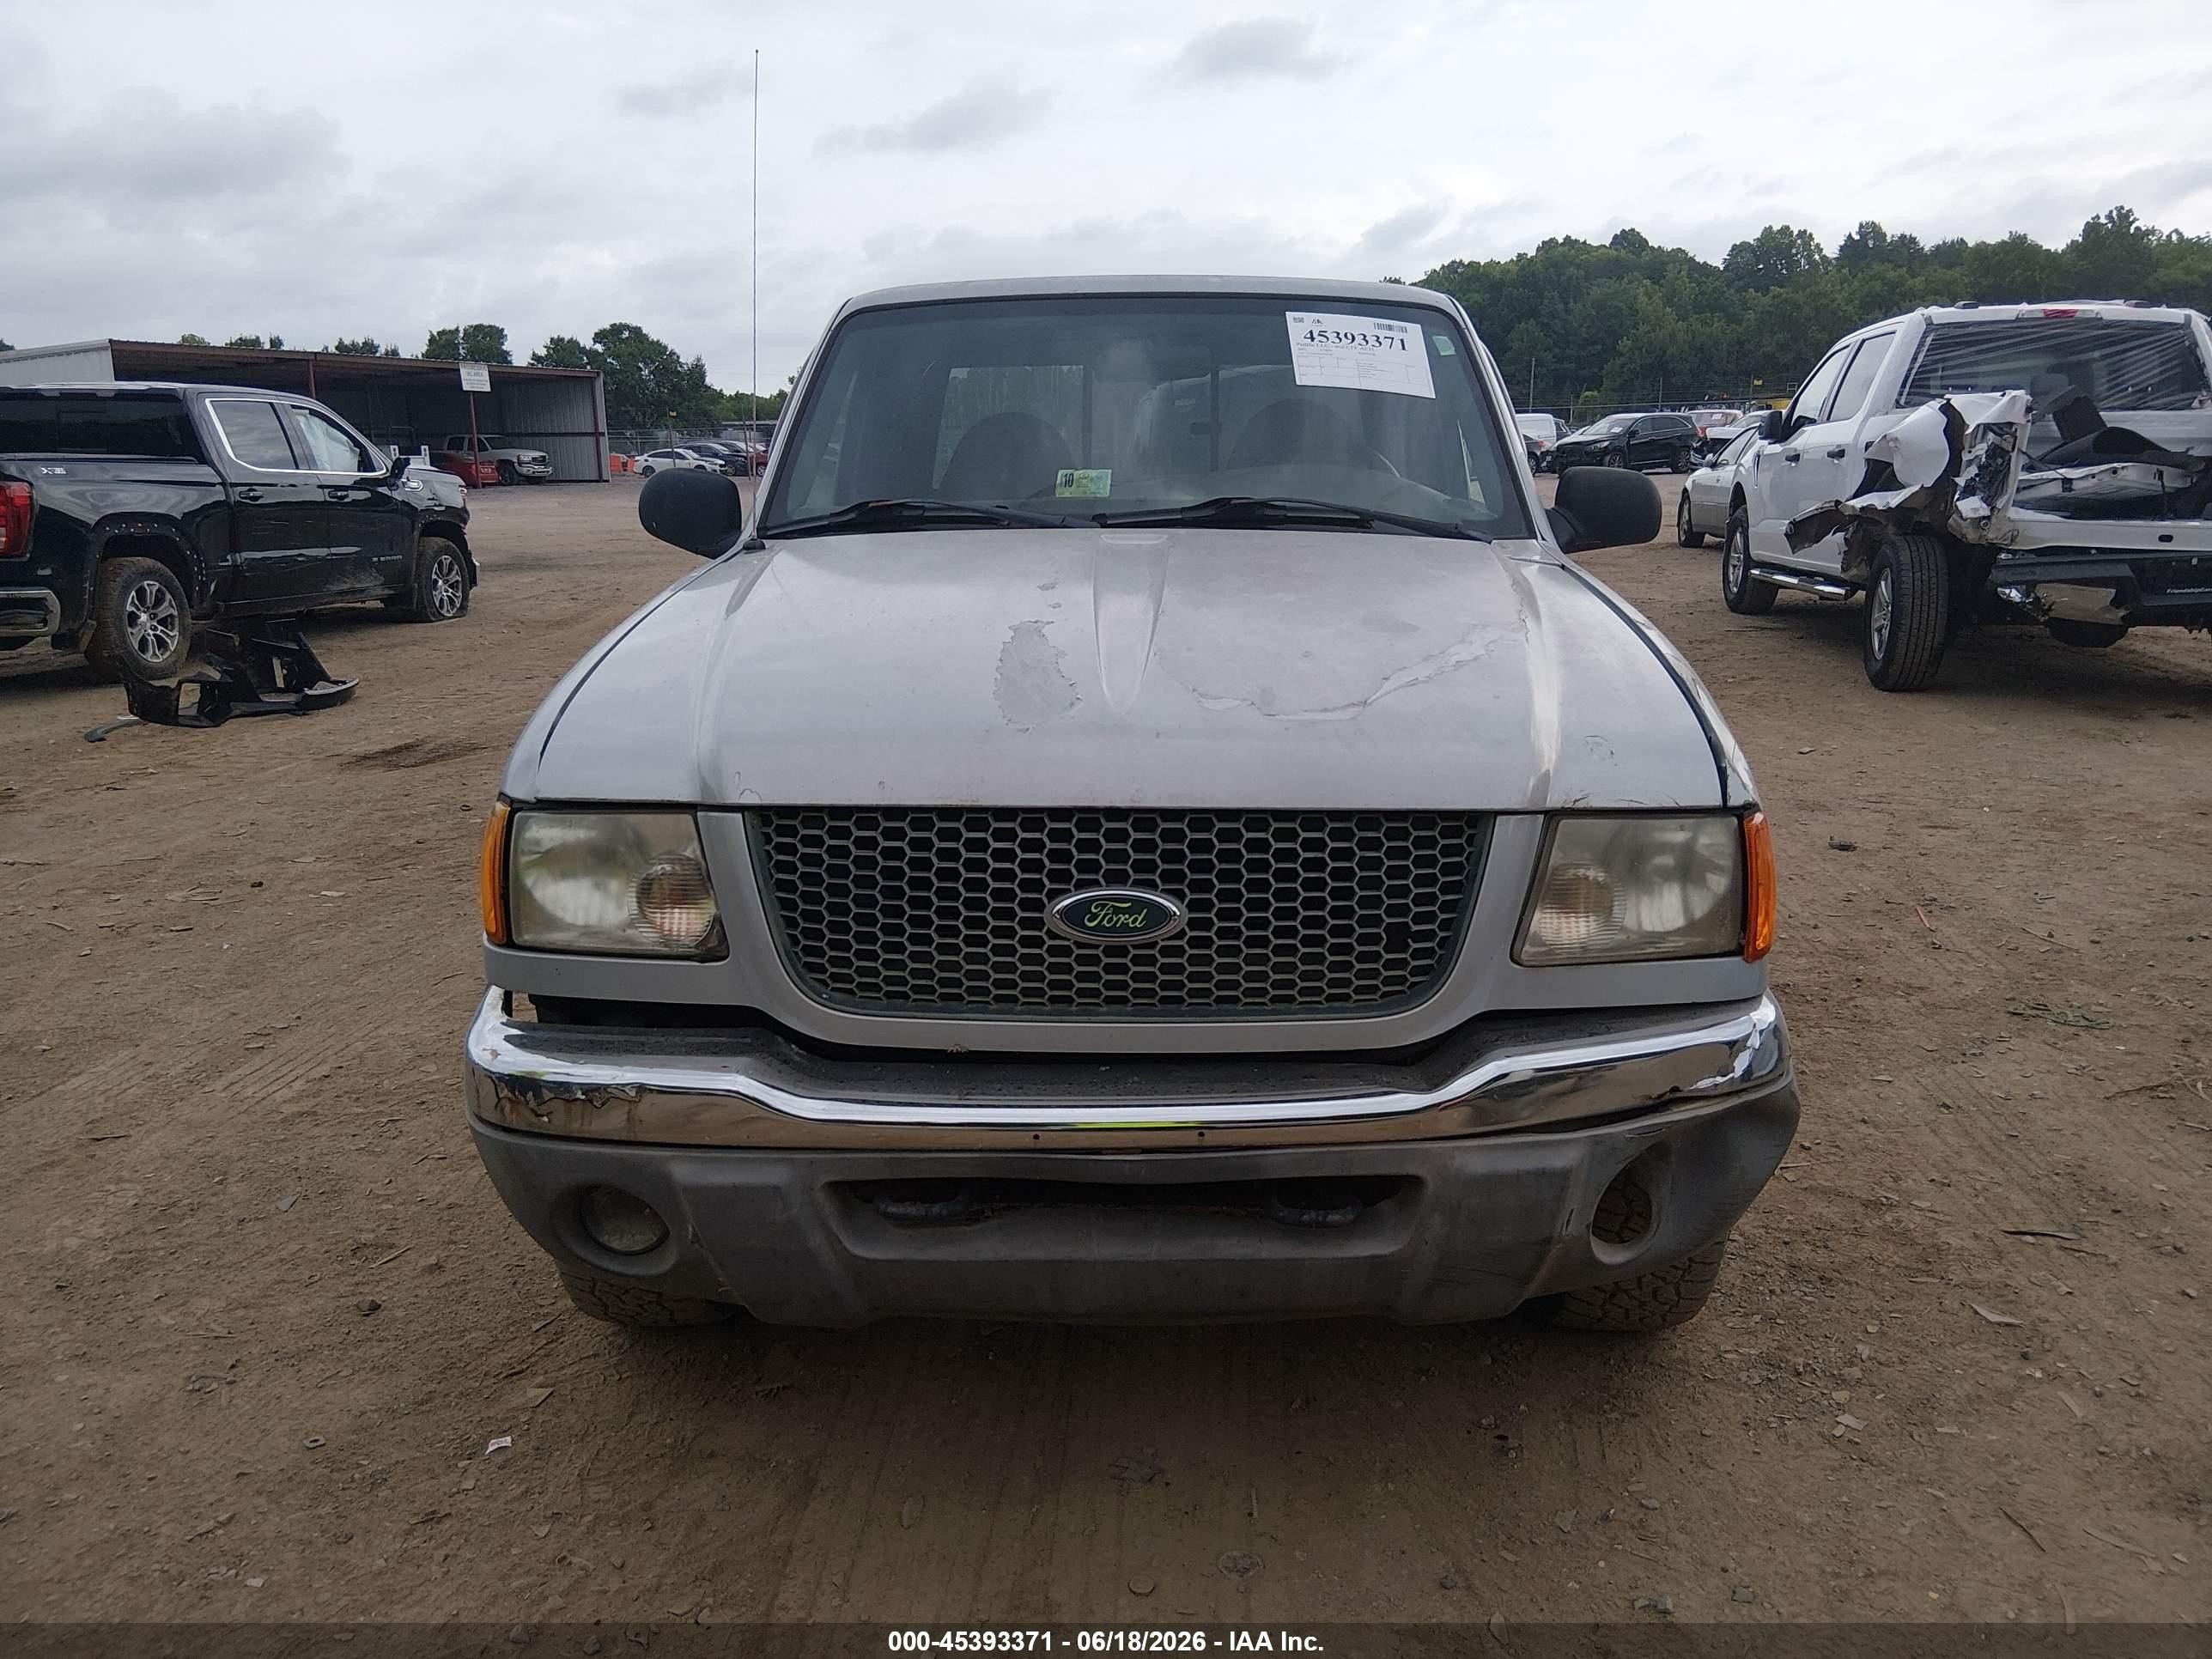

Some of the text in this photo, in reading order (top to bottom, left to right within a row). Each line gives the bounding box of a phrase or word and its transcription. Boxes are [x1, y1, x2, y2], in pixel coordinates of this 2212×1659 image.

[1304, 329, 1408, 352] 45393371
[1064, 472, 1074, 488] 10
[1085, 901, 1148, 927] Ford
